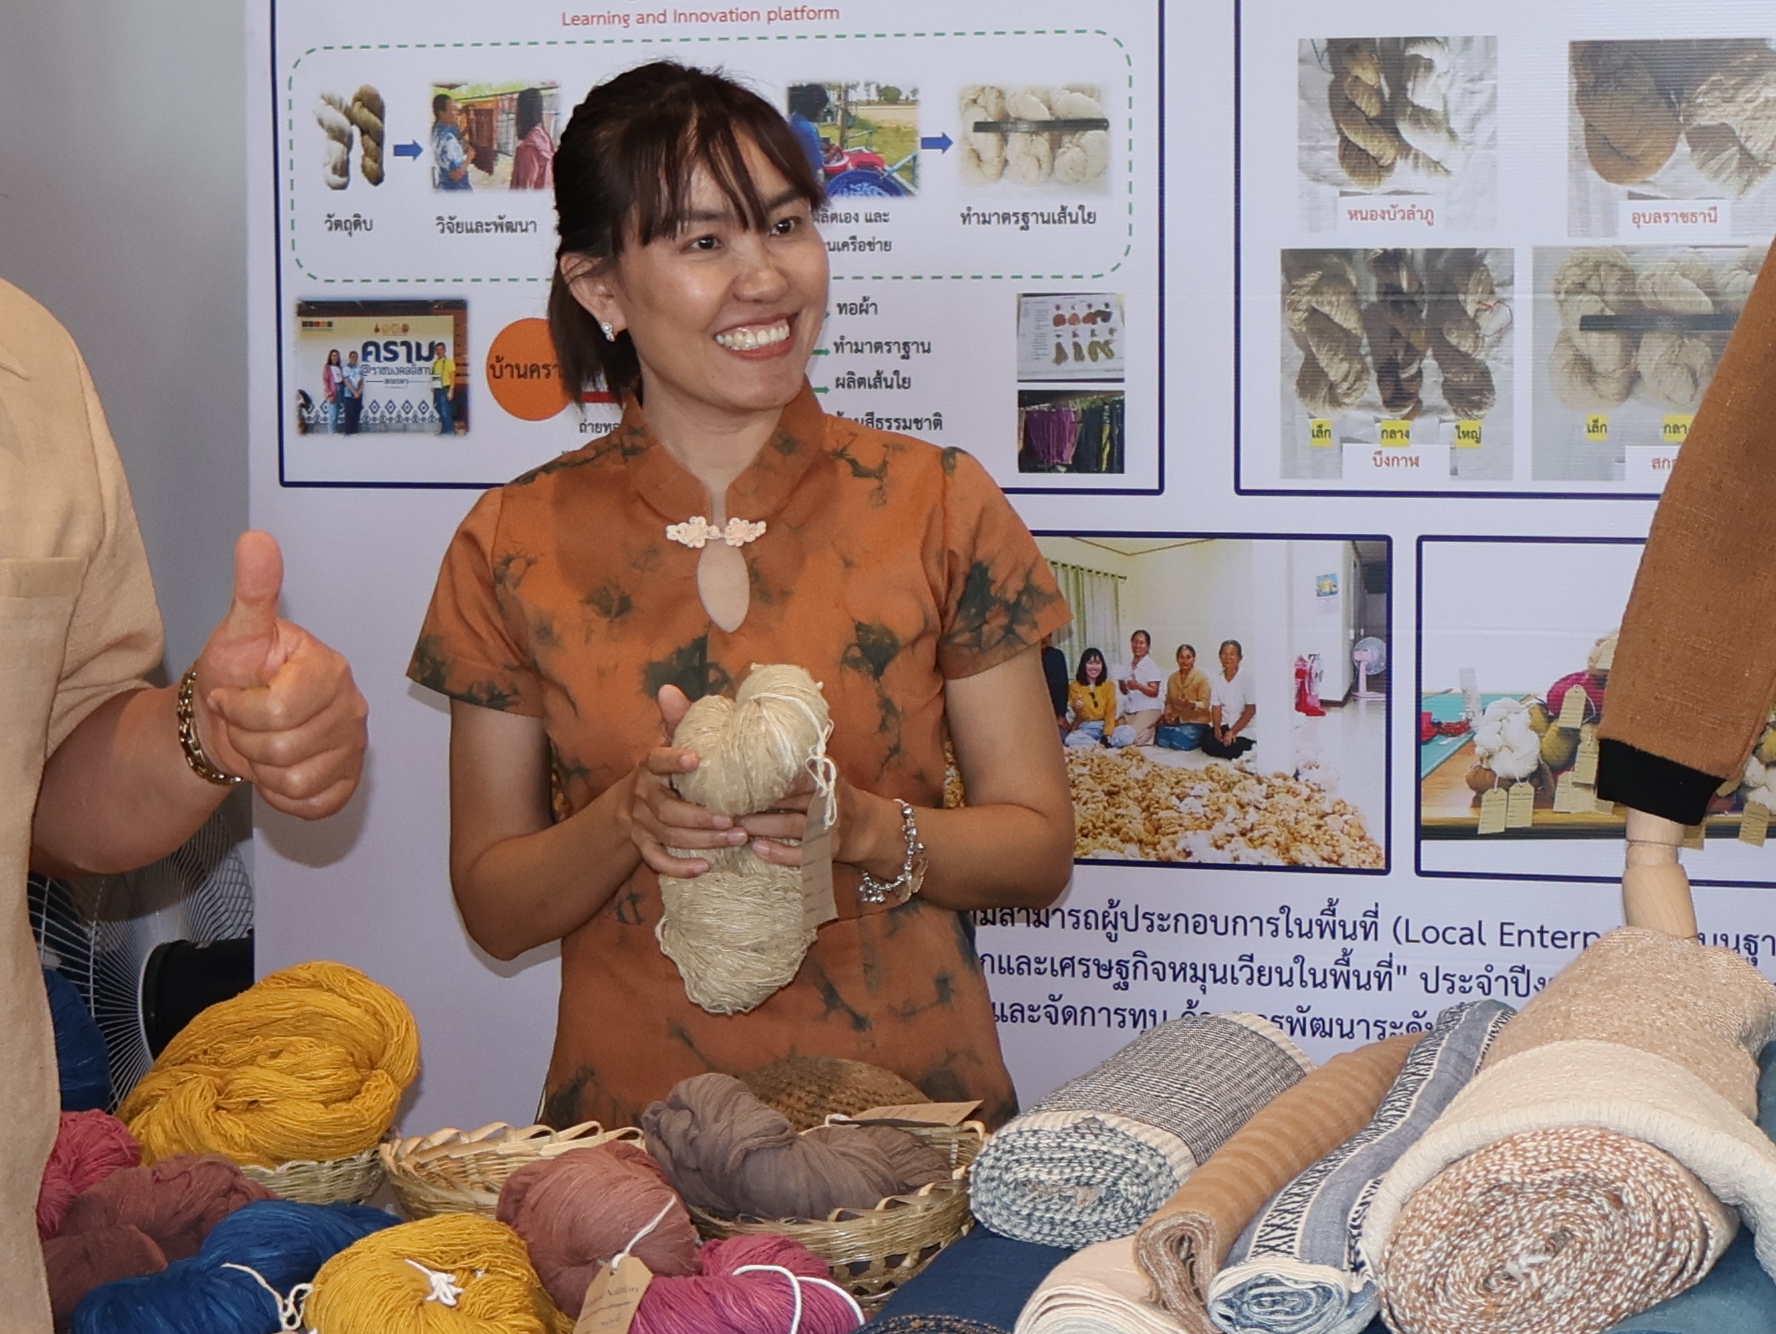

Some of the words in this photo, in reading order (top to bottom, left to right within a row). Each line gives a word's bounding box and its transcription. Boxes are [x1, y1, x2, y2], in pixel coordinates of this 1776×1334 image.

[561, 10, 632, 30] Learning
[635, 9, 668, 25] and
[671, 6, 762, 25] Innovation
[766, 3, 841, 25] platform
[435, 213, 538, 238] วิจัยและพัฒนา
[959, 204, 1098, 232] ทำมาตรฐานเส้นใย
[1347, 203, 1436, 228] หนองบัวลำภู
[1631, 204, 1719, 228] อุบลราชธานี
[836, 296, 879, 317] ทอผ้า
[835, 369, 912, 391] ผลิตเส้นใย
[1392, 915, 1487, 947] (Local
[979, 947, 1408, 994] กและเศรษฐกิจหมุนเวียนในพื้นที่"
